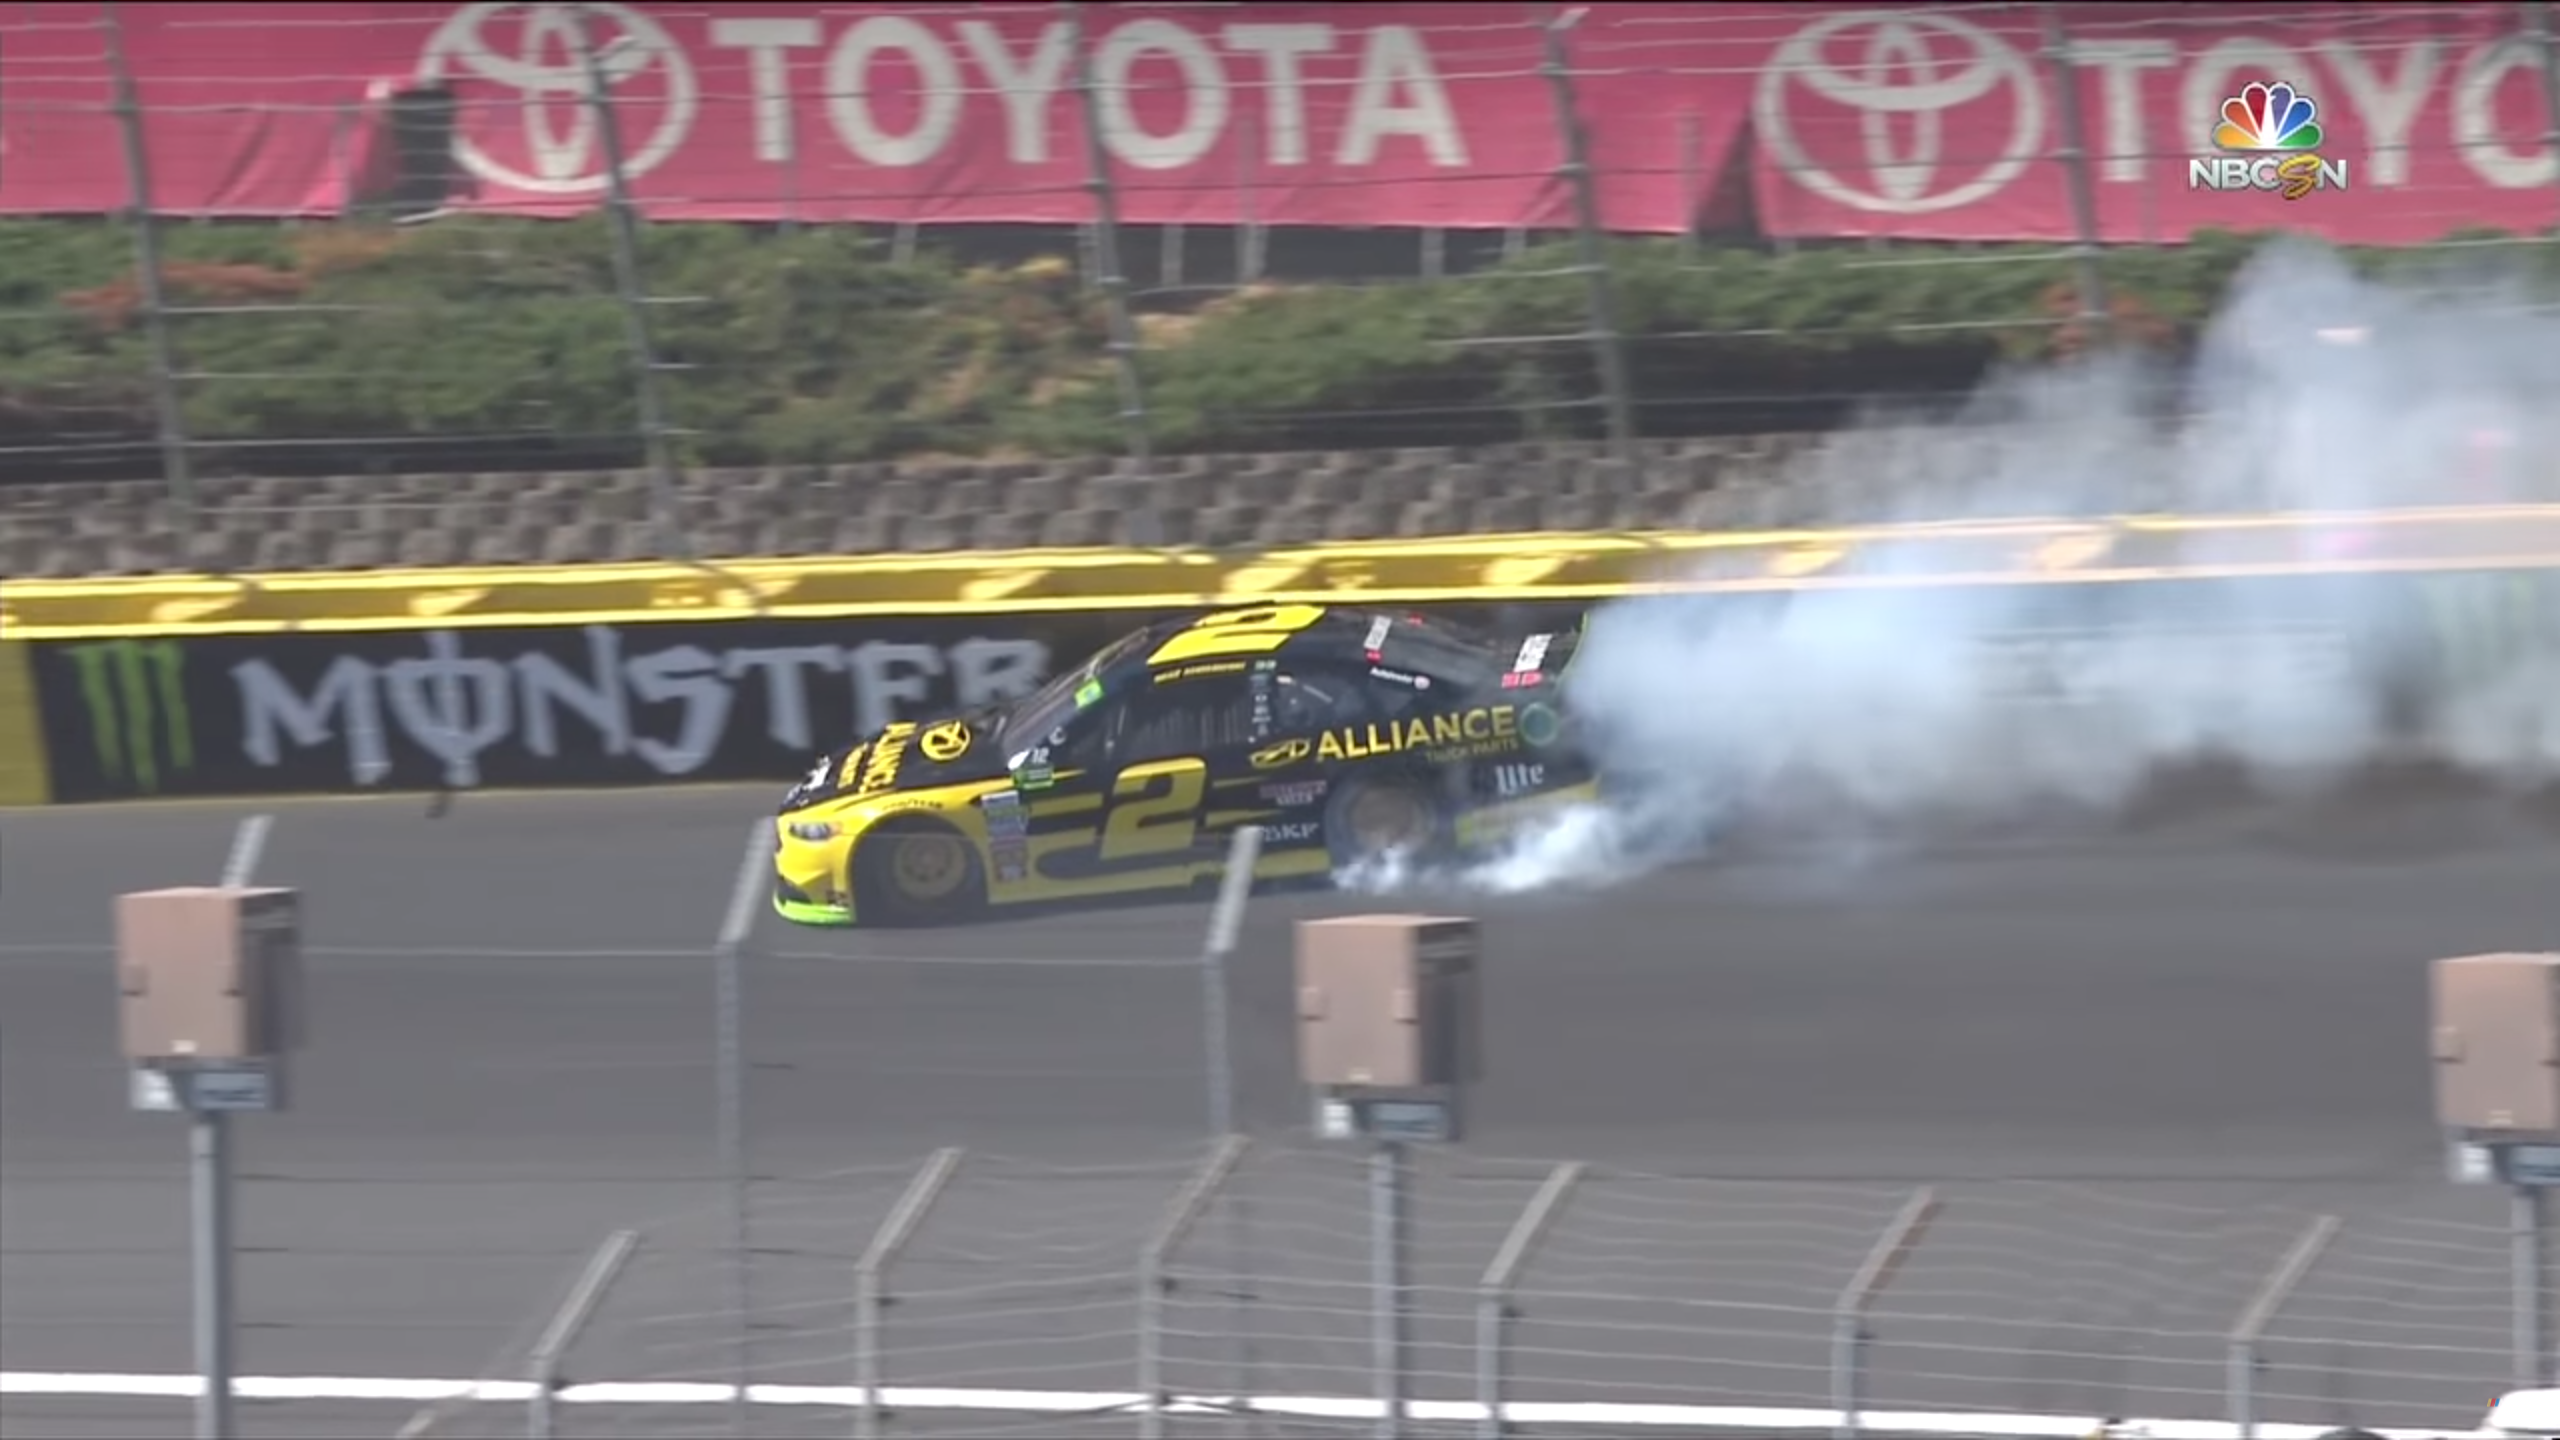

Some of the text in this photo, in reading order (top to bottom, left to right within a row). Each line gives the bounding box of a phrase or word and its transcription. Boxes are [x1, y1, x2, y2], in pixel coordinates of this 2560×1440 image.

[708, 14, 1472, 168] TOYOTA
[1146, 603, 1327, 666] 2
[1317, 704, 1516, 762] ALLIANCE
[1472, 737, 1519, 756] PARTS
[1100, 755, 1205, 860] 2
